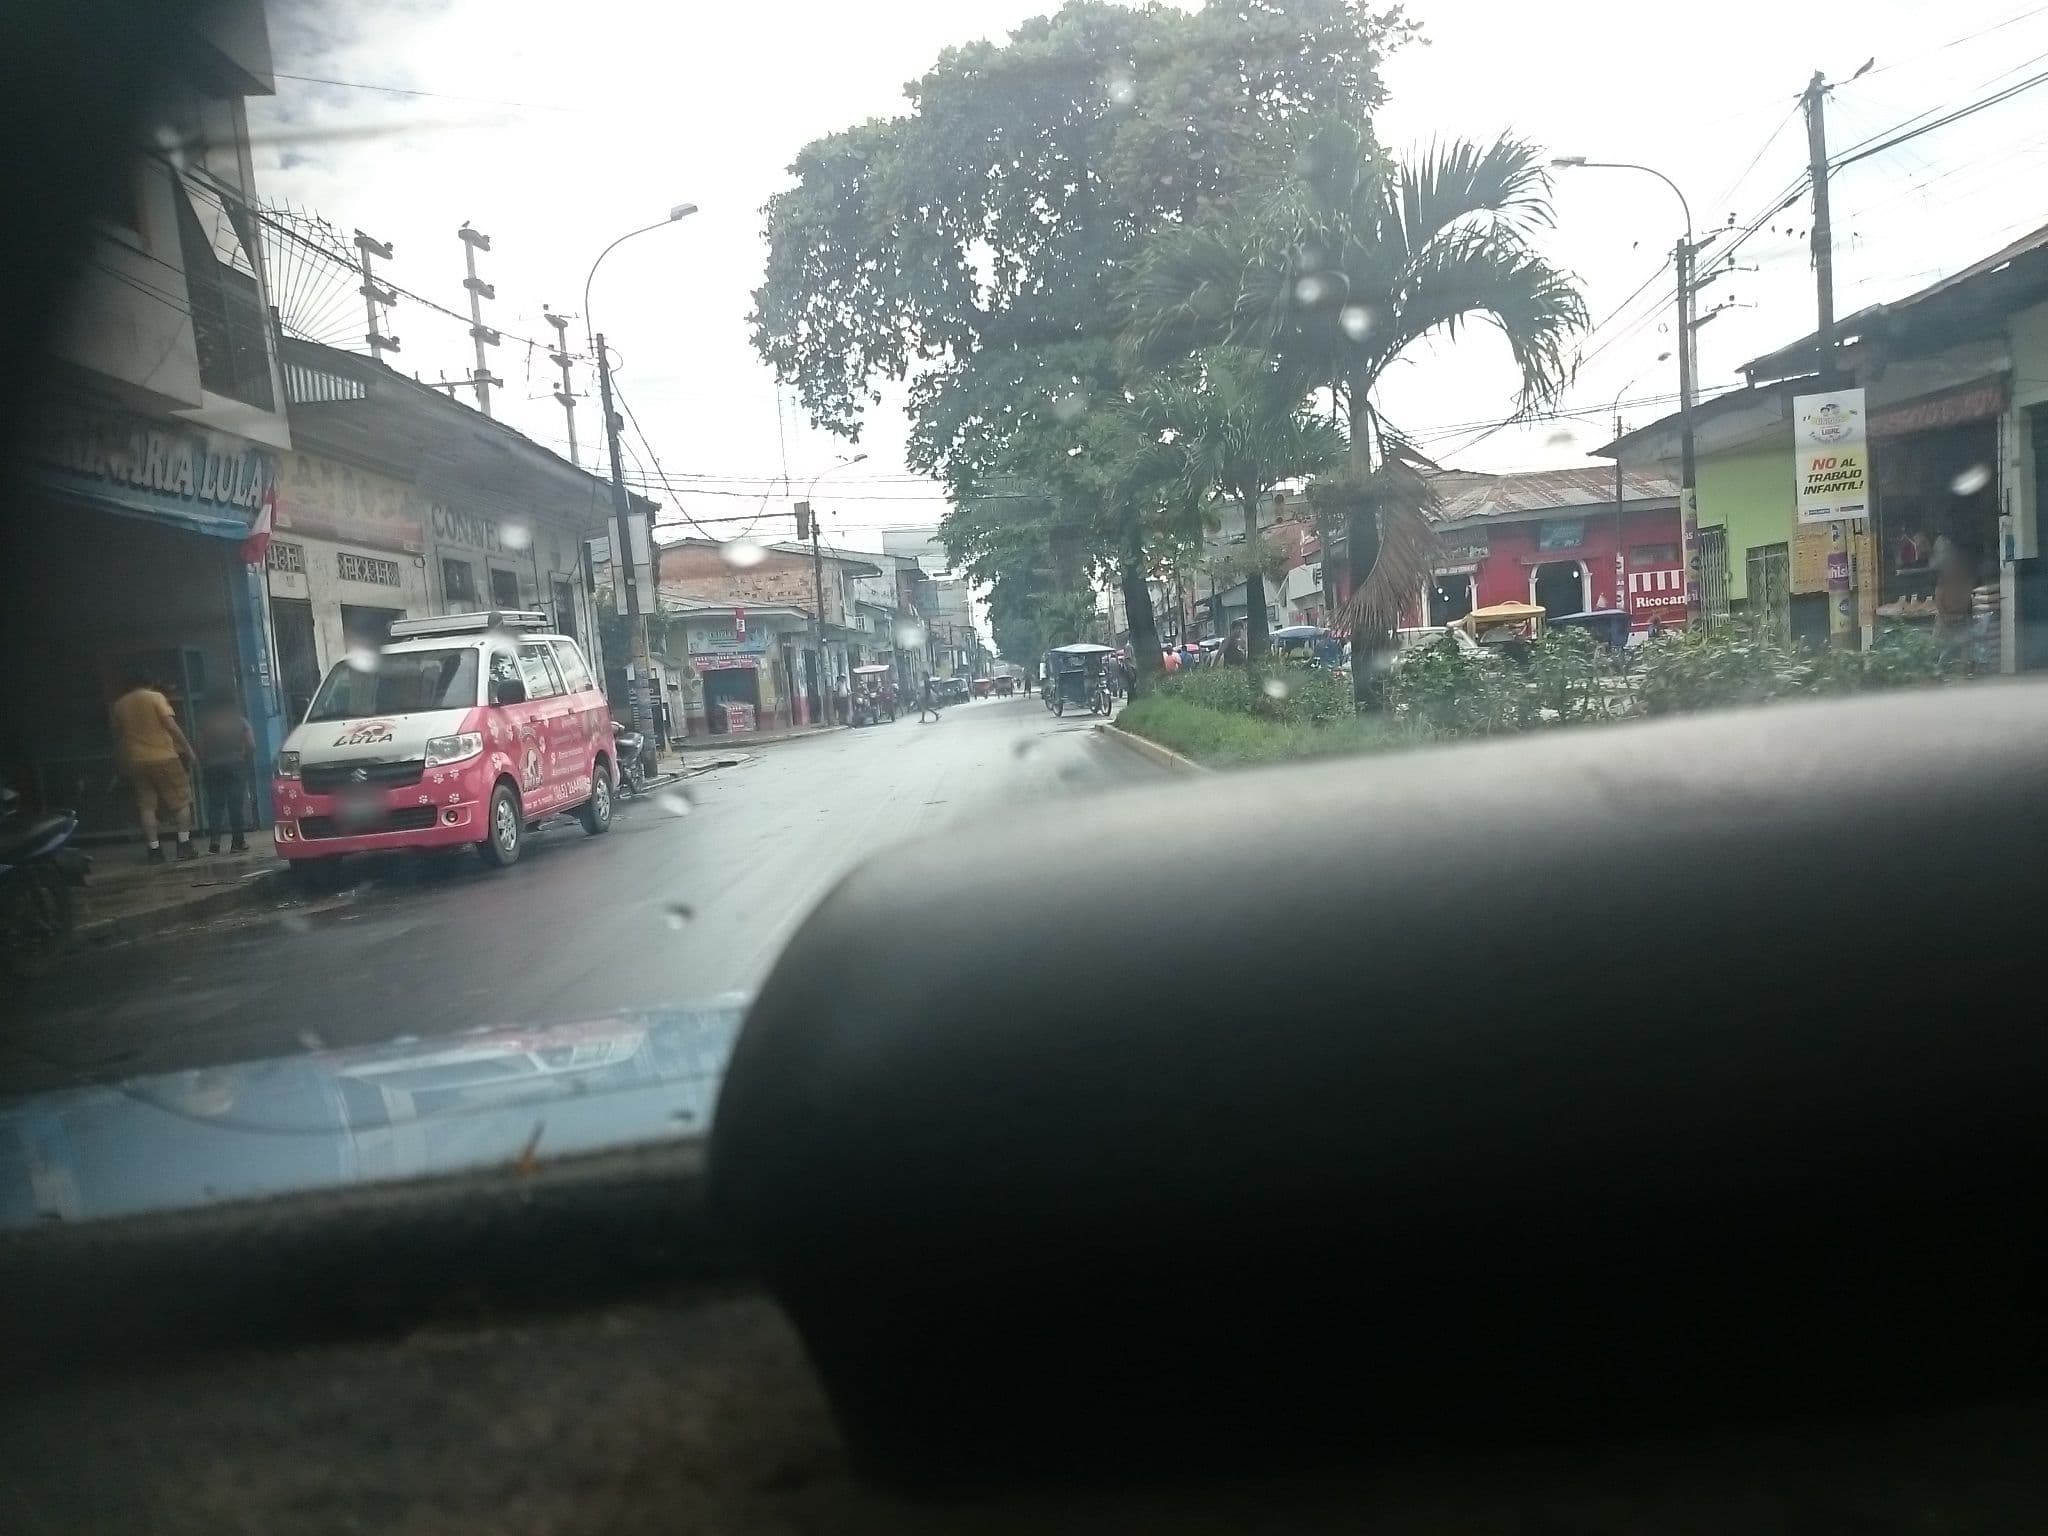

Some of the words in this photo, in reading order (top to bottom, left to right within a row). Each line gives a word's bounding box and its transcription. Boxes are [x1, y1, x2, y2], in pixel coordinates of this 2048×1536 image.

[1812, 457, 1837, 471] NO
[1840, 458, 1857, 468] AL
[201, 446, 263, 508] LULA
[1807, 469, 1862, 484] TRABAJO
[1803, 480, 1865, 495] INFANTIL!
[1636, 594, 1686, 609] Ricocan
[333, 733, 393, 748] LULA
